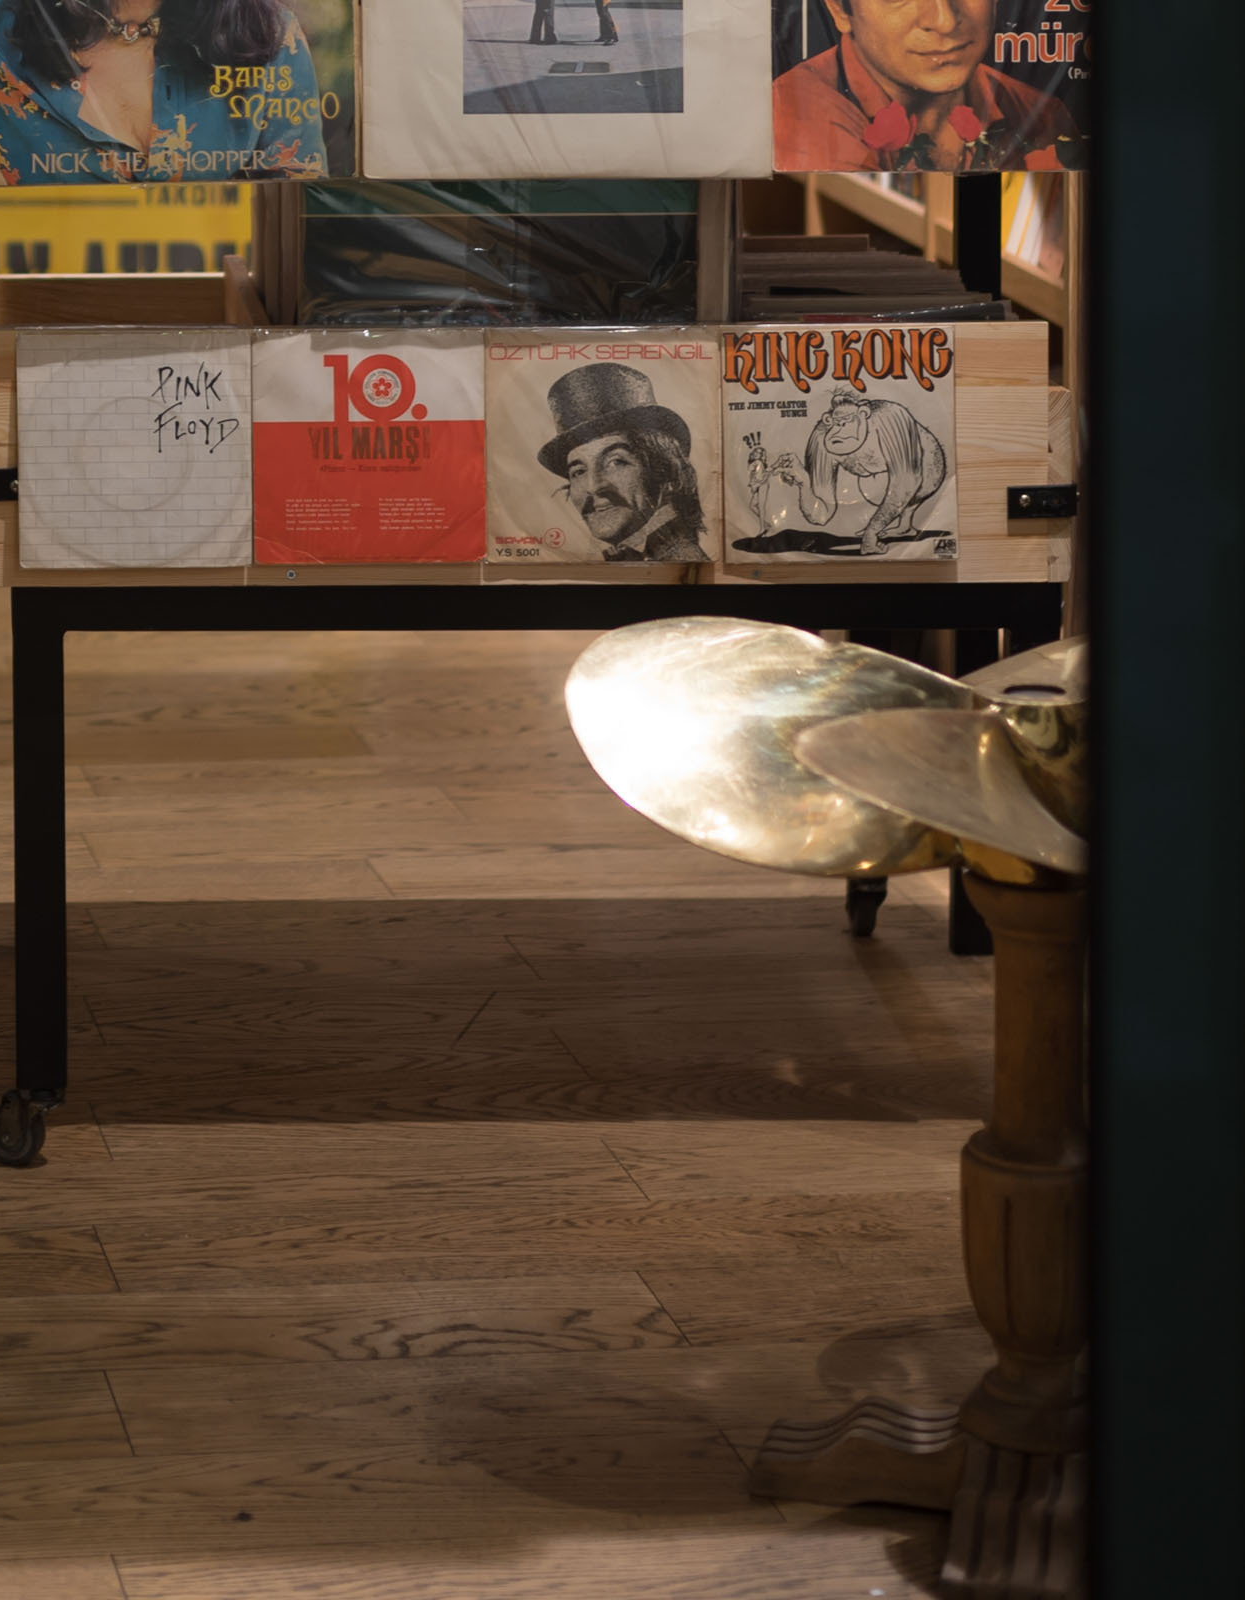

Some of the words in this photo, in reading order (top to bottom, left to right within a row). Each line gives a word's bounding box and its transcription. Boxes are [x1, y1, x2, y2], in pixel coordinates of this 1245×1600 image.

[994, 21, 1092, 64] mür
[31, 152, 91, 175] NICK
[96, 151, 146, 173] THE
[488, 342, 593, 361] ÖZTÜRK
[723, 329, 829, 395] KING
[831, 327, 954, 394] KONG
[150, 360, 223, 410] PINK
[728, 401, 745, 411] THE
[747, 400, 776, 410] JIMMY
[776, 399, 808, 409] CASTOR
[780, 409, 808, 418] BUNCH
[152, 400, 240, 454] FLOYD
[307, 426, 344, 461] YIL
[515, 547, 540, 558] 5001
